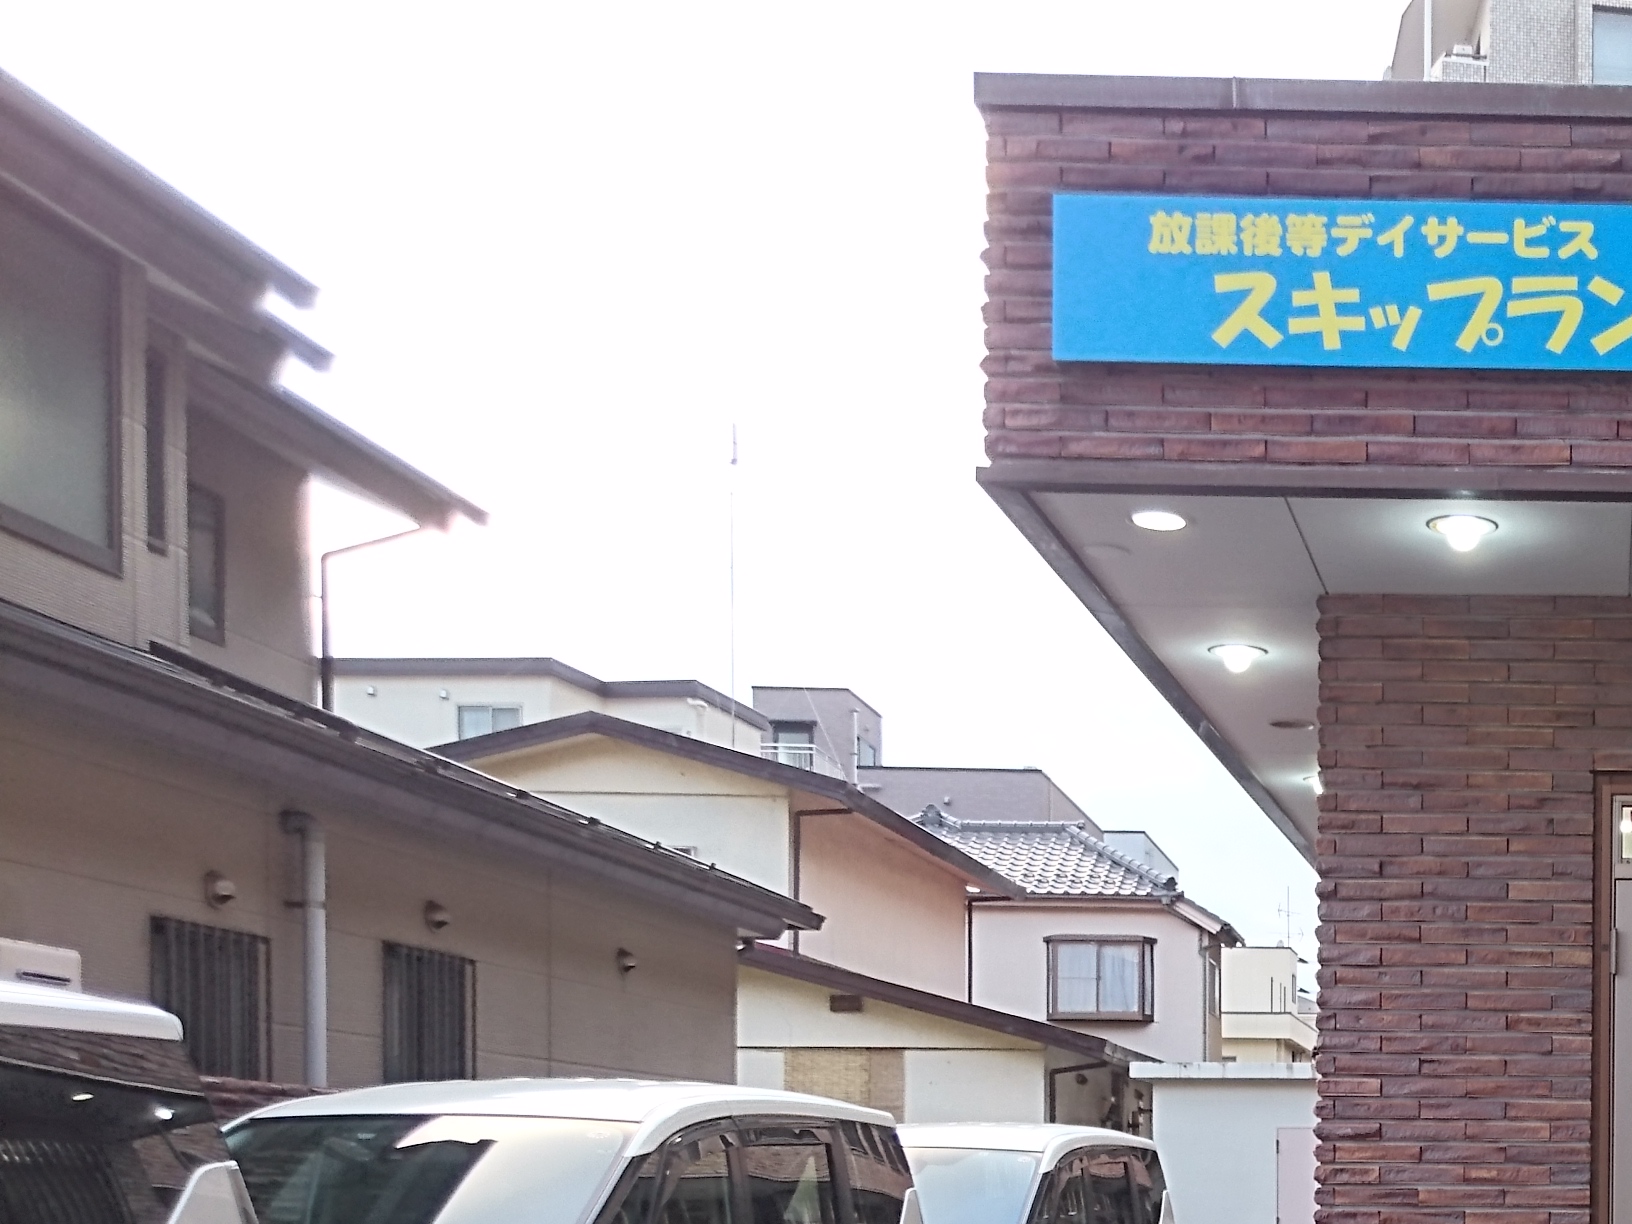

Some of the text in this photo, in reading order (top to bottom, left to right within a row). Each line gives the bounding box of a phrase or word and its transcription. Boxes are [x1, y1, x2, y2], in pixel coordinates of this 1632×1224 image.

[1149, 212, 1598, 258] 放課後等デイサービス
